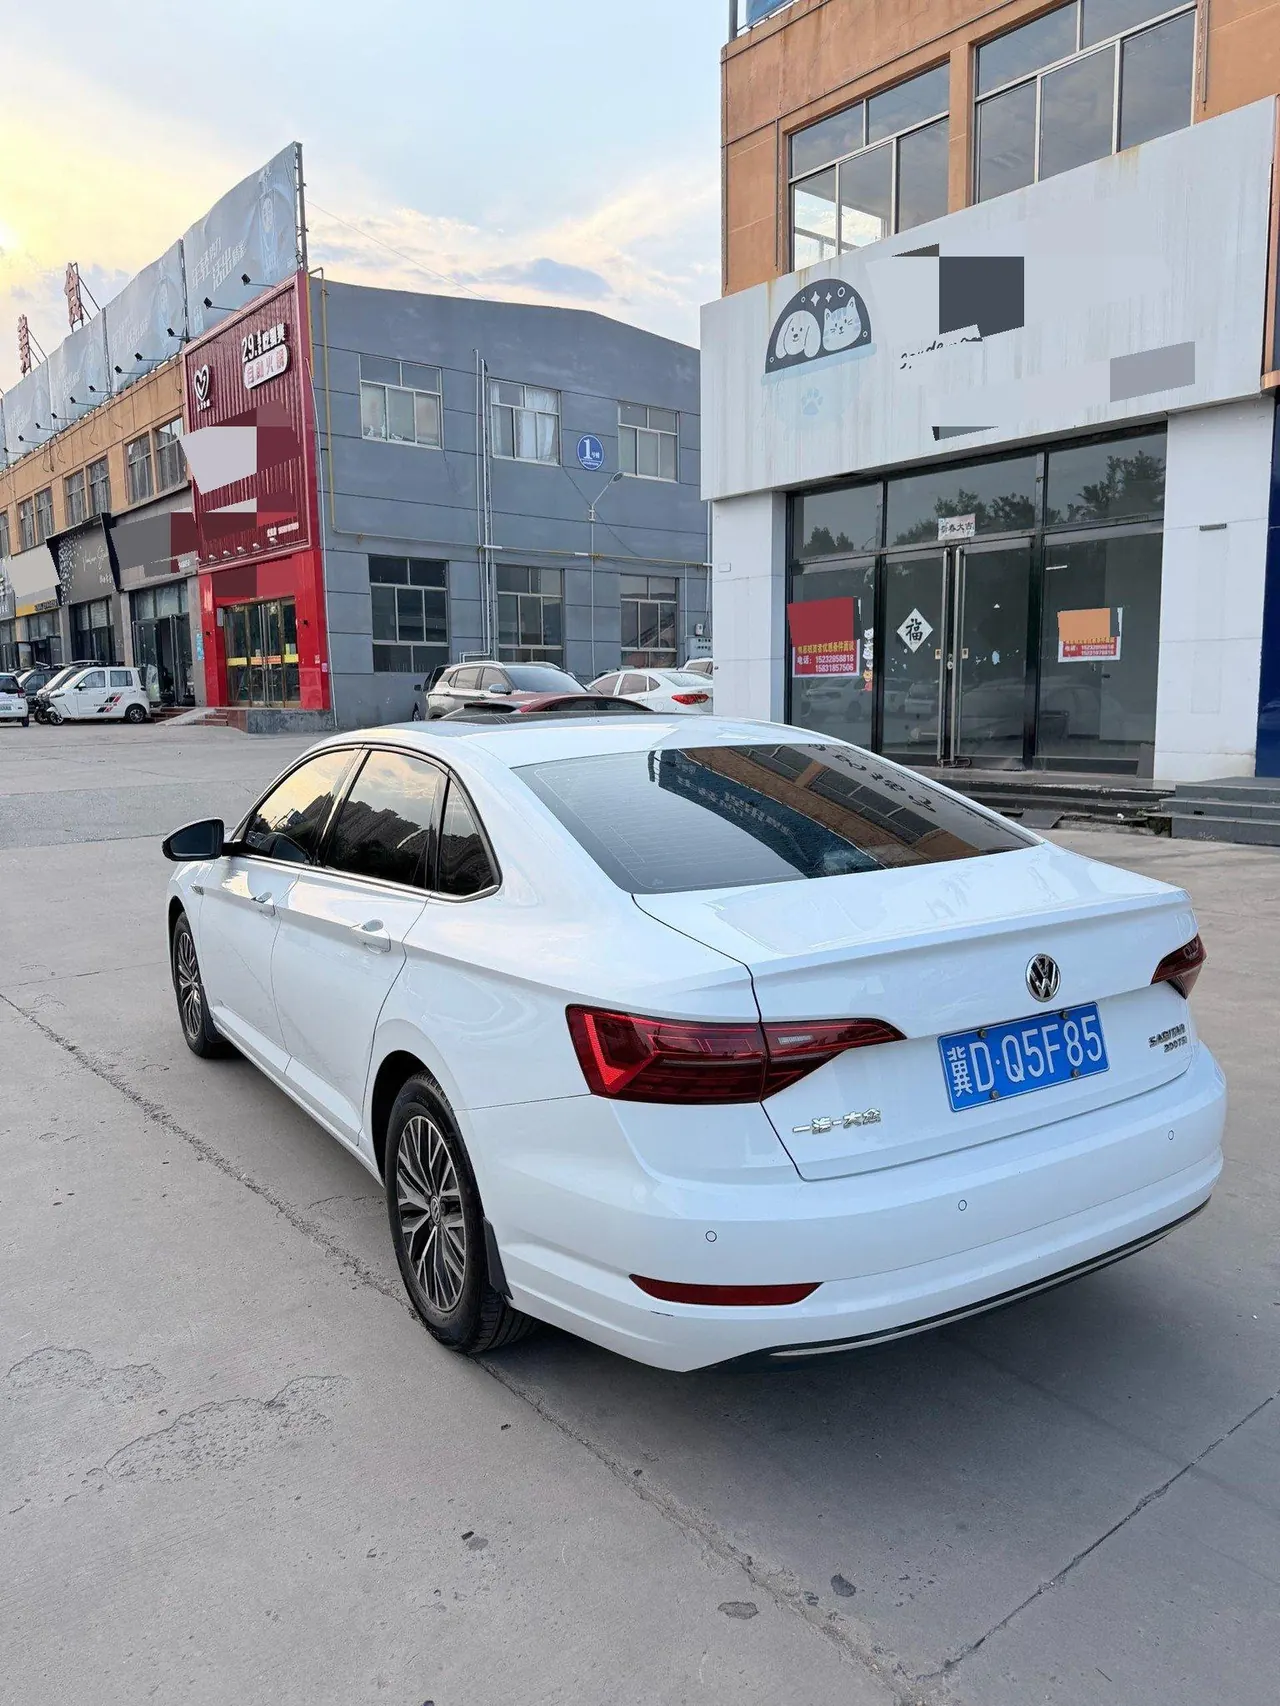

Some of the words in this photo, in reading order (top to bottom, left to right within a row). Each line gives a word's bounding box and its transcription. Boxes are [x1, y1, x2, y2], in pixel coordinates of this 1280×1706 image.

[905, 618, 923, 641] 福
[1148, 1023, 1186, 1048] SAGITAR
[1163, 1036, 1188, 1053] 200TSI
